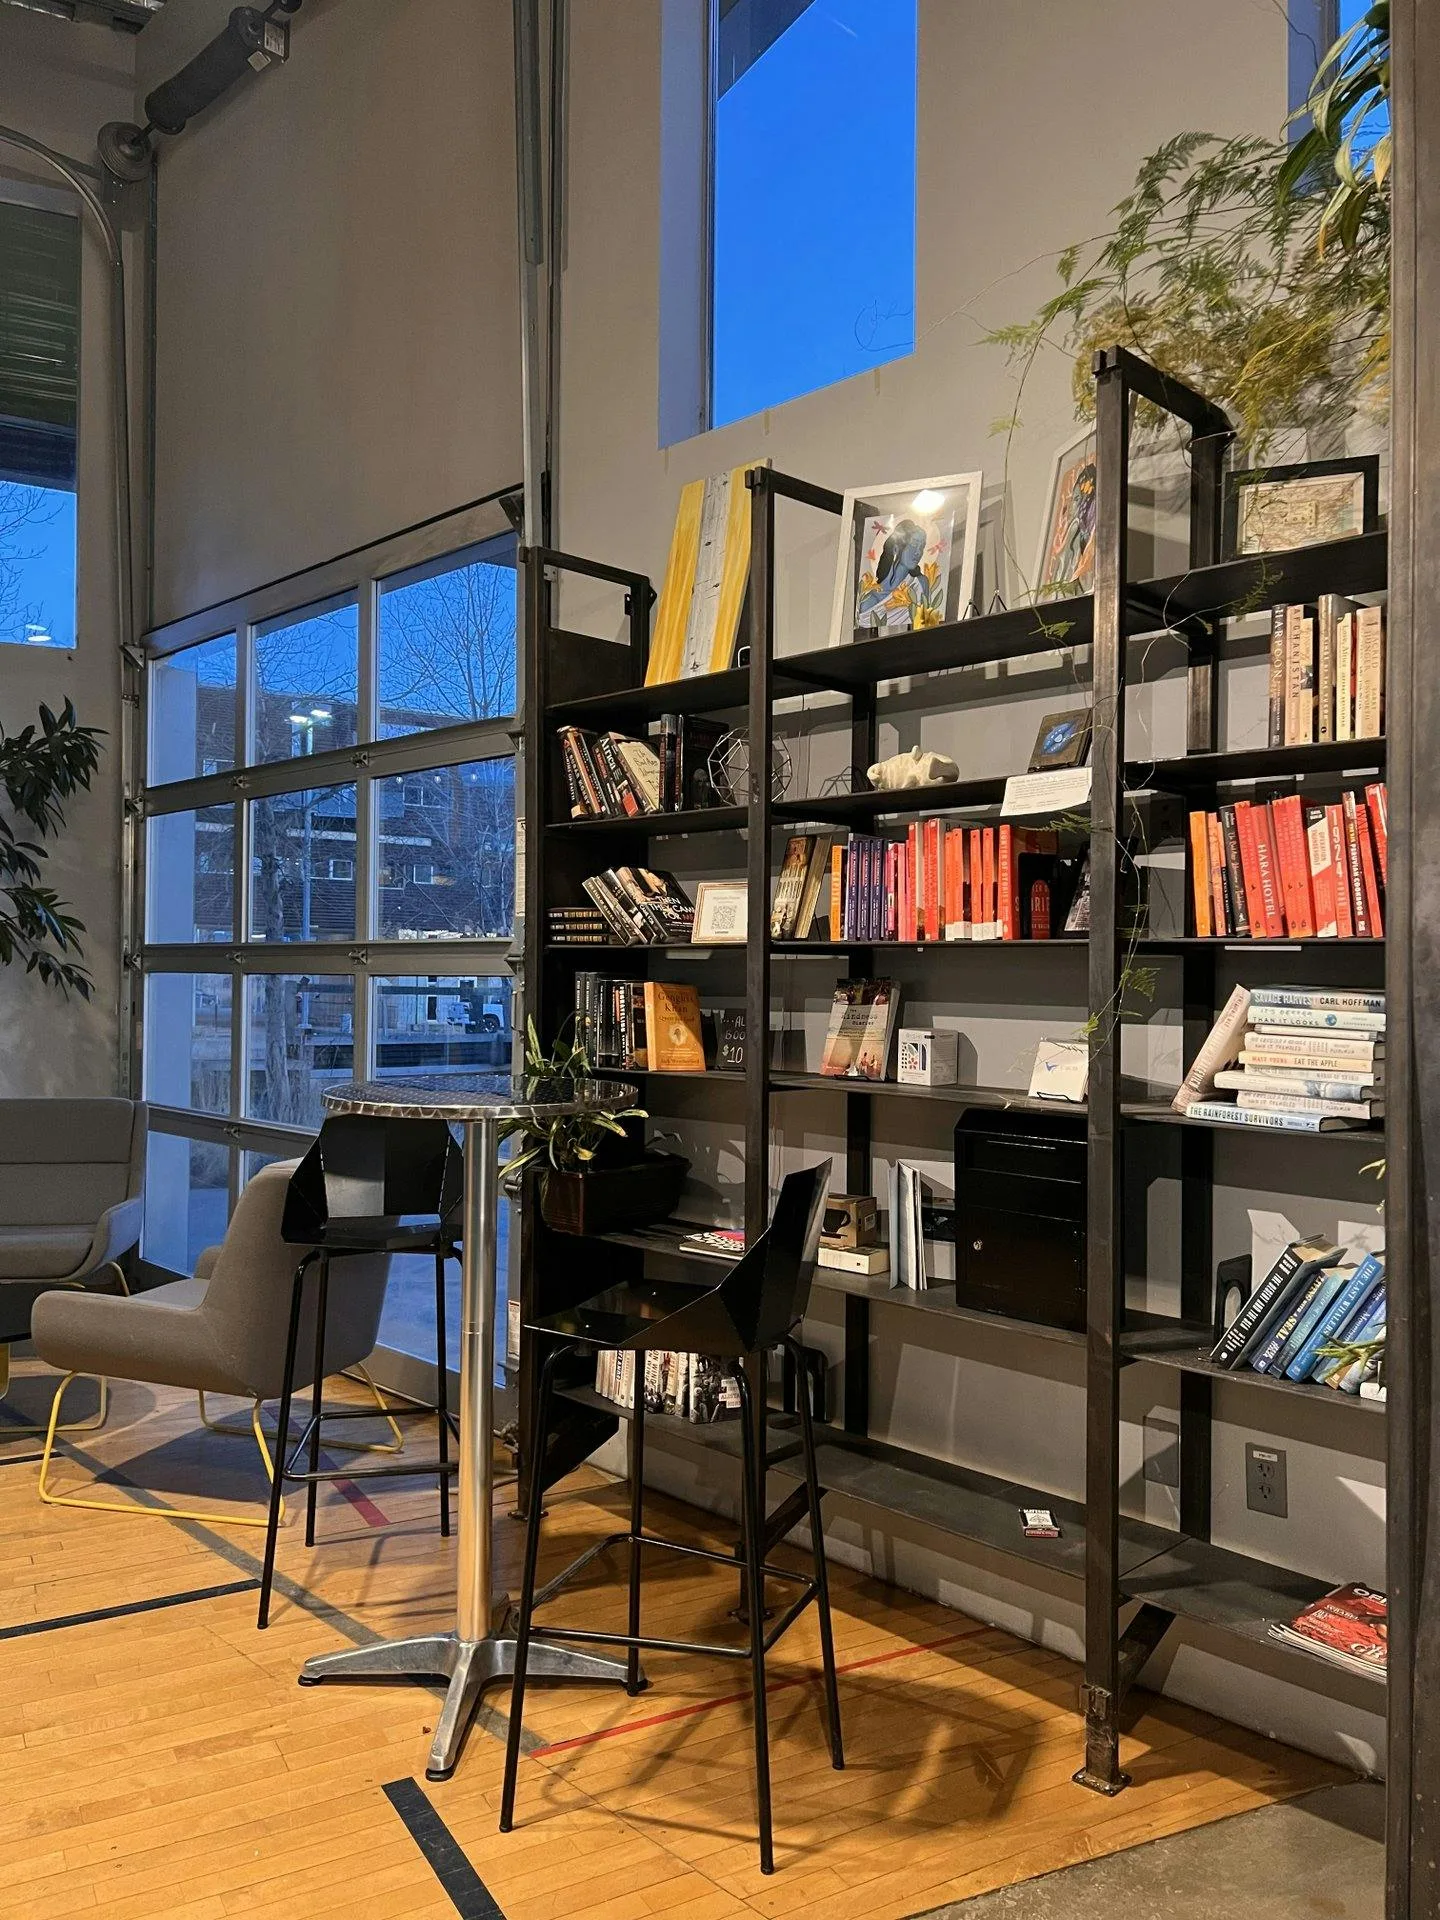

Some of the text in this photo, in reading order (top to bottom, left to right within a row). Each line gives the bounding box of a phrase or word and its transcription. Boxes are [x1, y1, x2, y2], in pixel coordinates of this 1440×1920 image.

[1273, 605, 1284, 682] HARPOON
[1291, 608, 1300, 698] AFGHANISTAN
[1350, 843, 1360, 877] PERUVIAN
[1258, 844, 1275, 918] HARA HOTEL
[1354, 877, 1364, 916] COOKBOOK
[665, 1003, 688, 1012] Khan
[1320, 997, 1340, 1006] CARL
[1342, 998, 1381, 1007] HOFFMAN
[722, 1044, 744, 1063] $10
[1190, 1107, 1284, 1127] THE RAINFOREST SURVIVORS
[1271, 1273, 1284, 1286] THE
[1304, 1275, 1325, 1301] LIVING
[1258, 1281, 1278, 1303] DESERT
[1322, 1263, 1376, 1336] THE LAST WHALERS
[1246, 1309, 1259, 1322] THE
[1252, 1299, 1266, 1313] AND
[1275, 1315, 1298, 1342] SEAL
